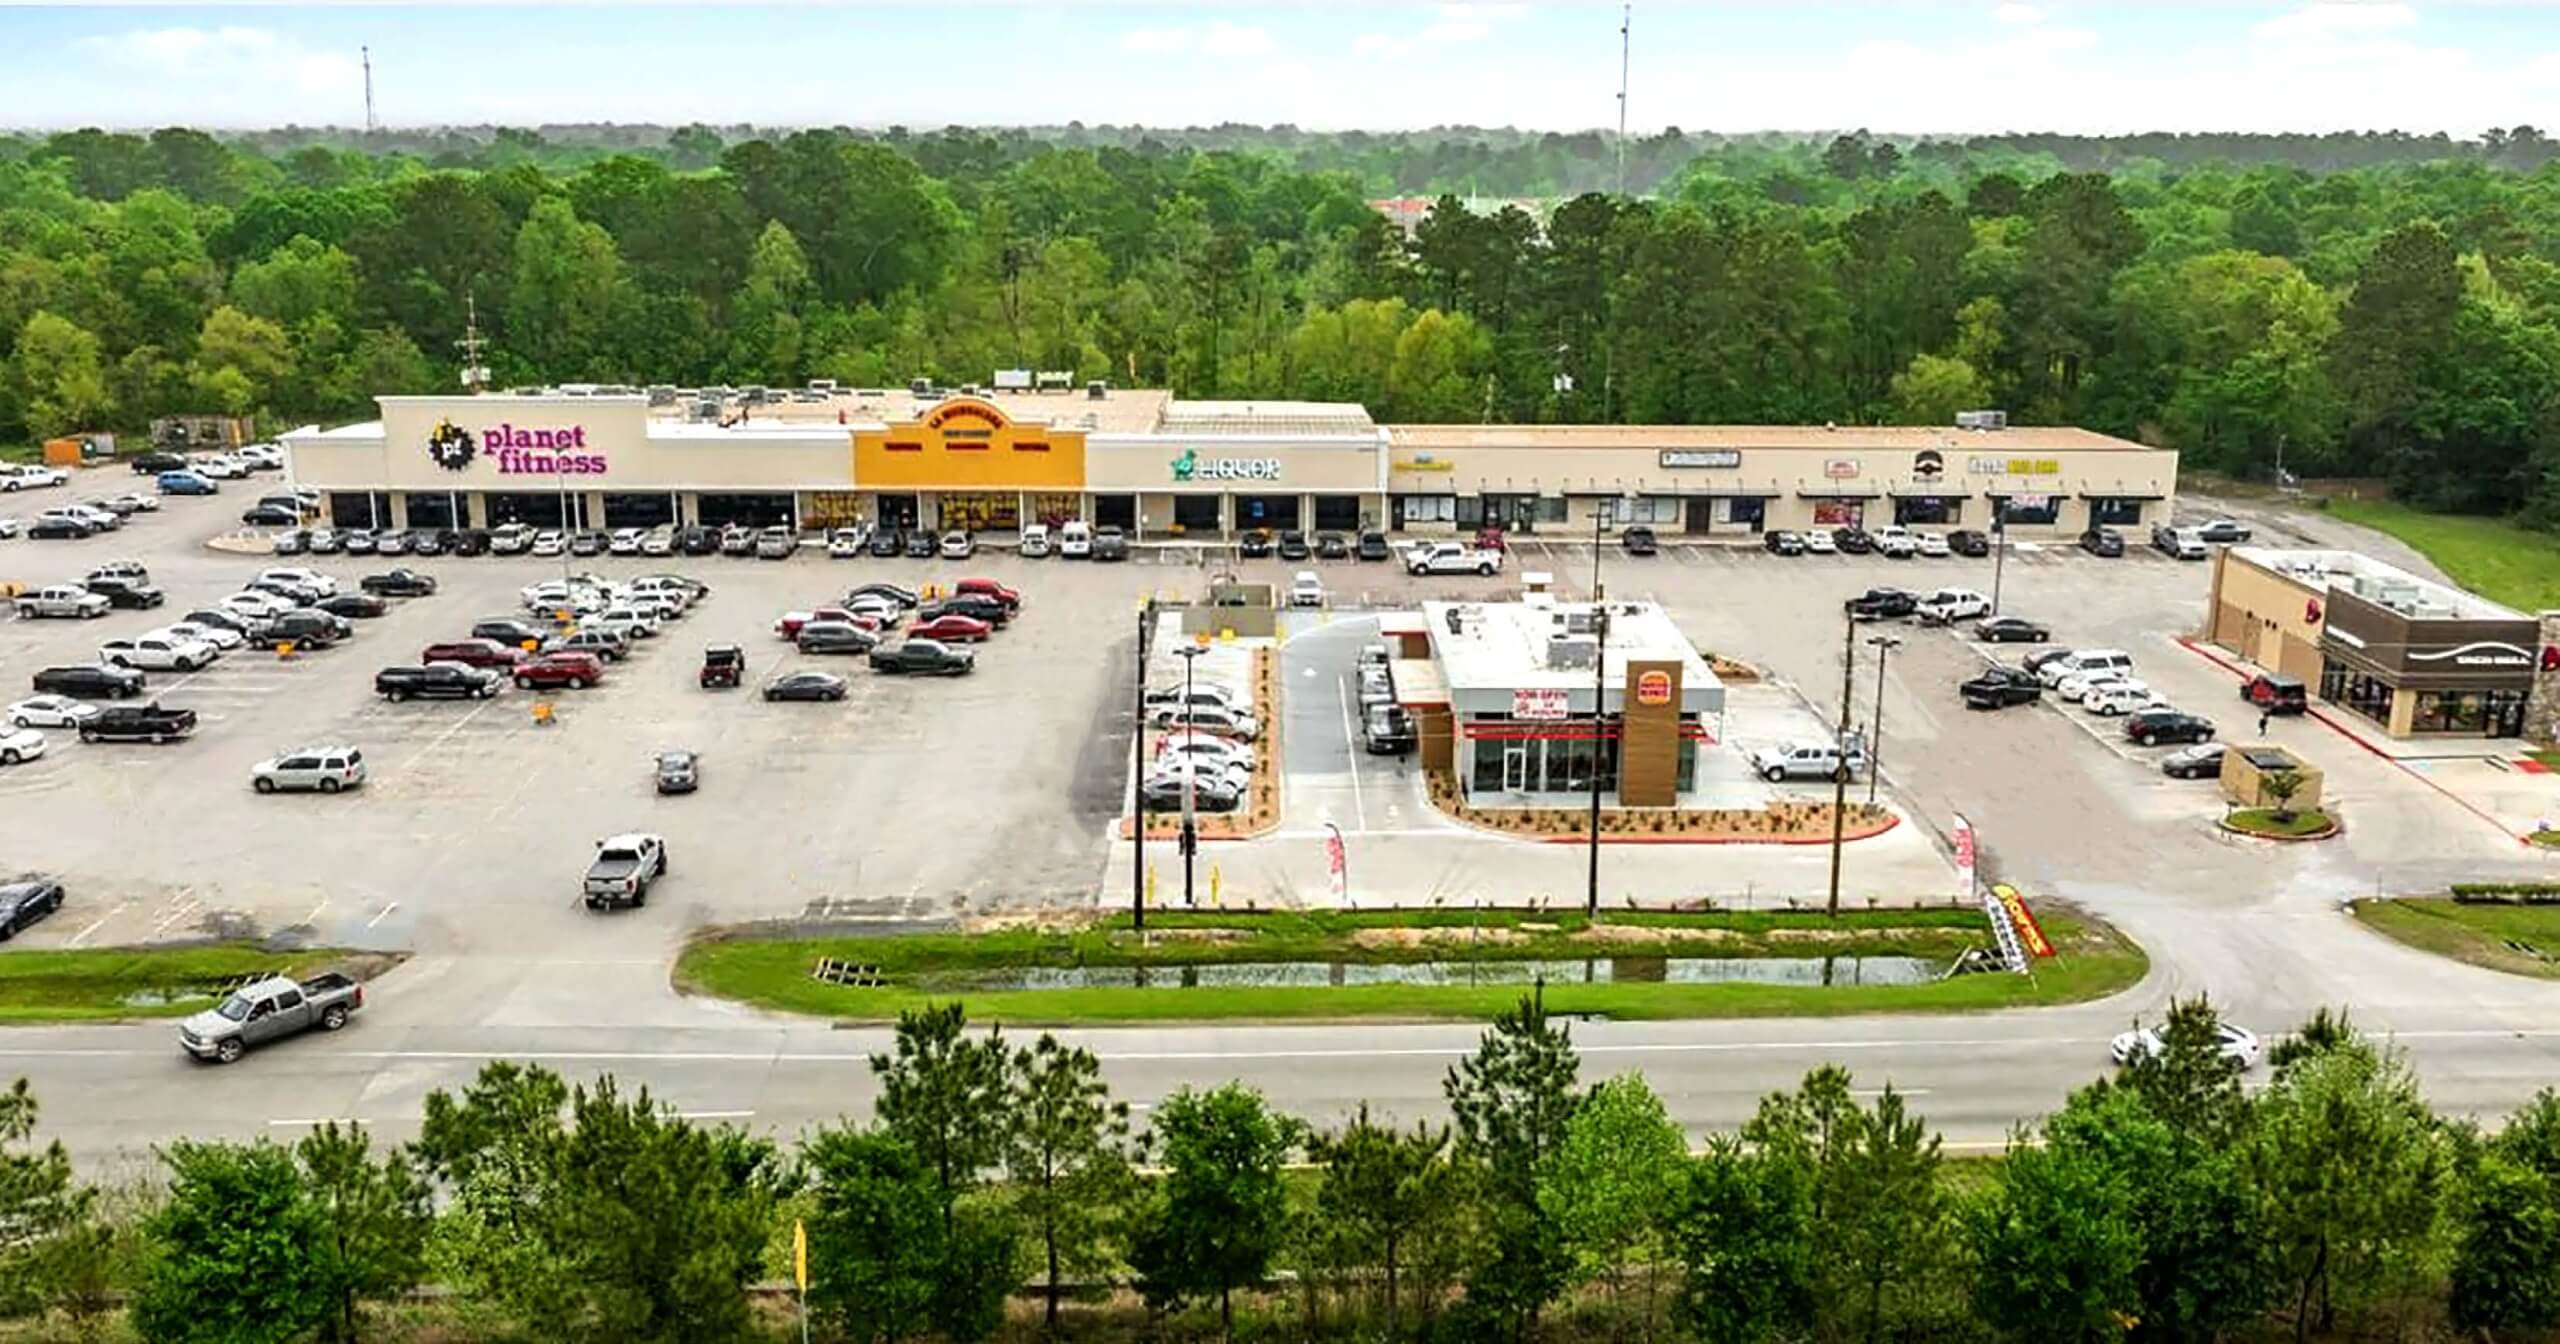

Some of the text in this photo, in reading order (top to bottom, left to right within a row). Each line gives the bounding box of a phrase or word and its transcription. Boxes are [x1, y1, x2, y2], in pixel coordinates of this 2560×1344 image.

[482, 423, 586, 455] planet
[499, 449, 607, 474] fitness
[1198, 458, 1281, 480] LIQUOR
